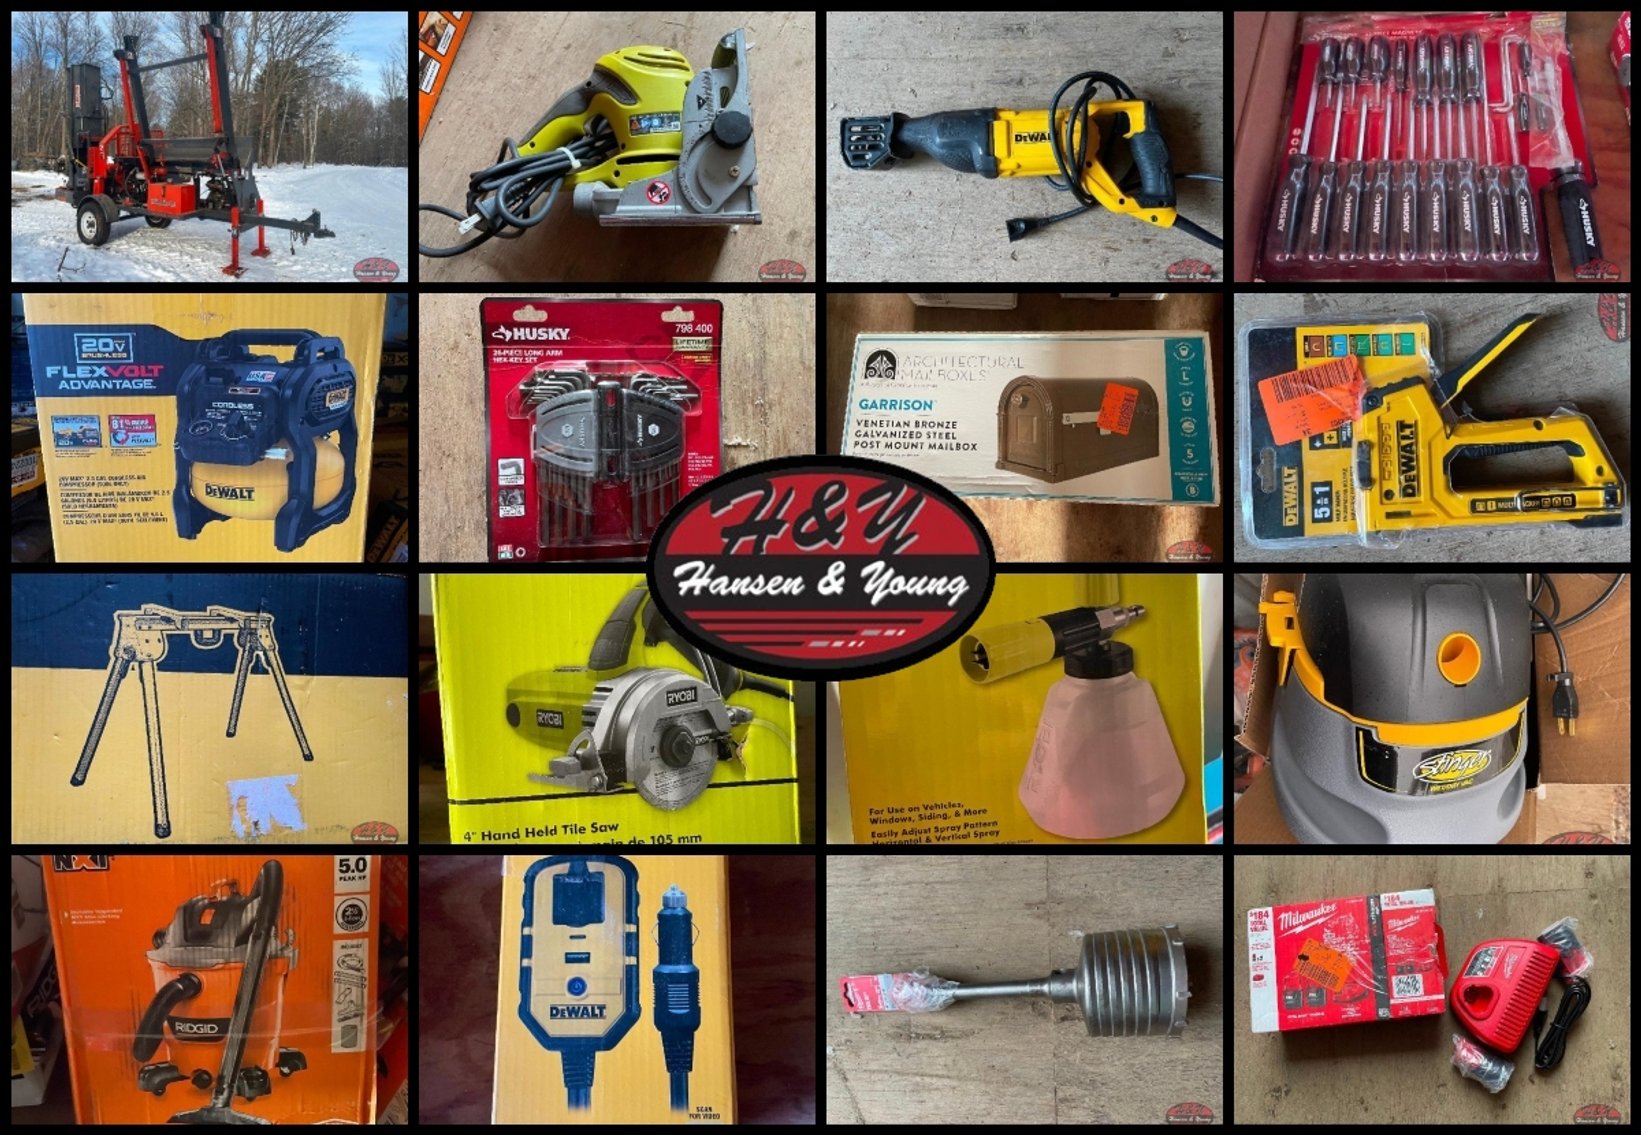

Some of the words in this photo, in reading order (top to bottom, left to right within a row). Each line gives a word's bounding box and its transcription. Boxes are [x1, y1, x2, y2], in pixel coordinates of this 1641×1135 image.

[1278, 199, 1288, 232] HUSKY
[1310, 200, 1321, 234] HUSKY
[1343, 202, 1352, 233] HUSKY
[1373, 202, 1382, 234] HUSKY
[1432, 201, 1440, 233] HUSKY
[1462, 200, 1472, 232] HUSKY
[1492, 205, 1501, 235] HUSKY
[1520, 203, 1530, 234] HUSKY
[1580, 210, 1596, 247] HUSKY
[513, 327, 569, 341] HUSKY
[675, 323, 693, 334] 798
[695, 323, 714, 334] 400
[524, 349, 544, 357] LONG
[46, 365, 164, 378] FLEXVOLT
[858, 398, 933, 411] GARRISON
[856, 418, 911, 429] VENETIAN
[914, 419, 958, 430] BRONZE
[854, 430, 922, 440] GALVANIZED
[926, 430, 958, 440] STEEL
[853, 440, 881, 450] POST
[884, 440, 925, 450] MOUNT
[928, 441, 978, 452] MAILBOX
[1400, 420, 1418, 498] DEWALT
[1313, 502, 1331, 520] 5
[667, 688, 696, 705] RYOBI
[537, 711, 563, 727] RYOBI
[1415, 749, 1492, 779] Stinger
[869, 808, 885, 816] For
[887, 806, 905, 815] Use
[922, 801, 964, 811] Vehicles,
[869, 815, 915, 825] Windows,
[918, 811, 951, 822] Siding,
[963, 807, 988, 817] More
[481, 828, 520, 842] Hand
[525, 825, 557, 838] Held
[562, 823, 586, 835] Tile
[590, 821, 619, 833] Saw
[871, 829, 898, 839] Easily
[901, 827, 931, 838] Adjust
[934, 825, 961, 835] Spray
[963, 820, 998, 830] Pattern
[925, 836, 932, 844] &
[935, 832, 971, 843] Vertical
[973, 829, 1000, 839] Spray
[650, 834, 673, 845] 105
[678, 834, 703, 844] mm
[338, 856, 368, 874] 5.0
[1250, 911, 1270, 920] $184
[1278, 903, 1337, 931] Milwaukee
[175, 1021, 219, 1034] RIDGID
